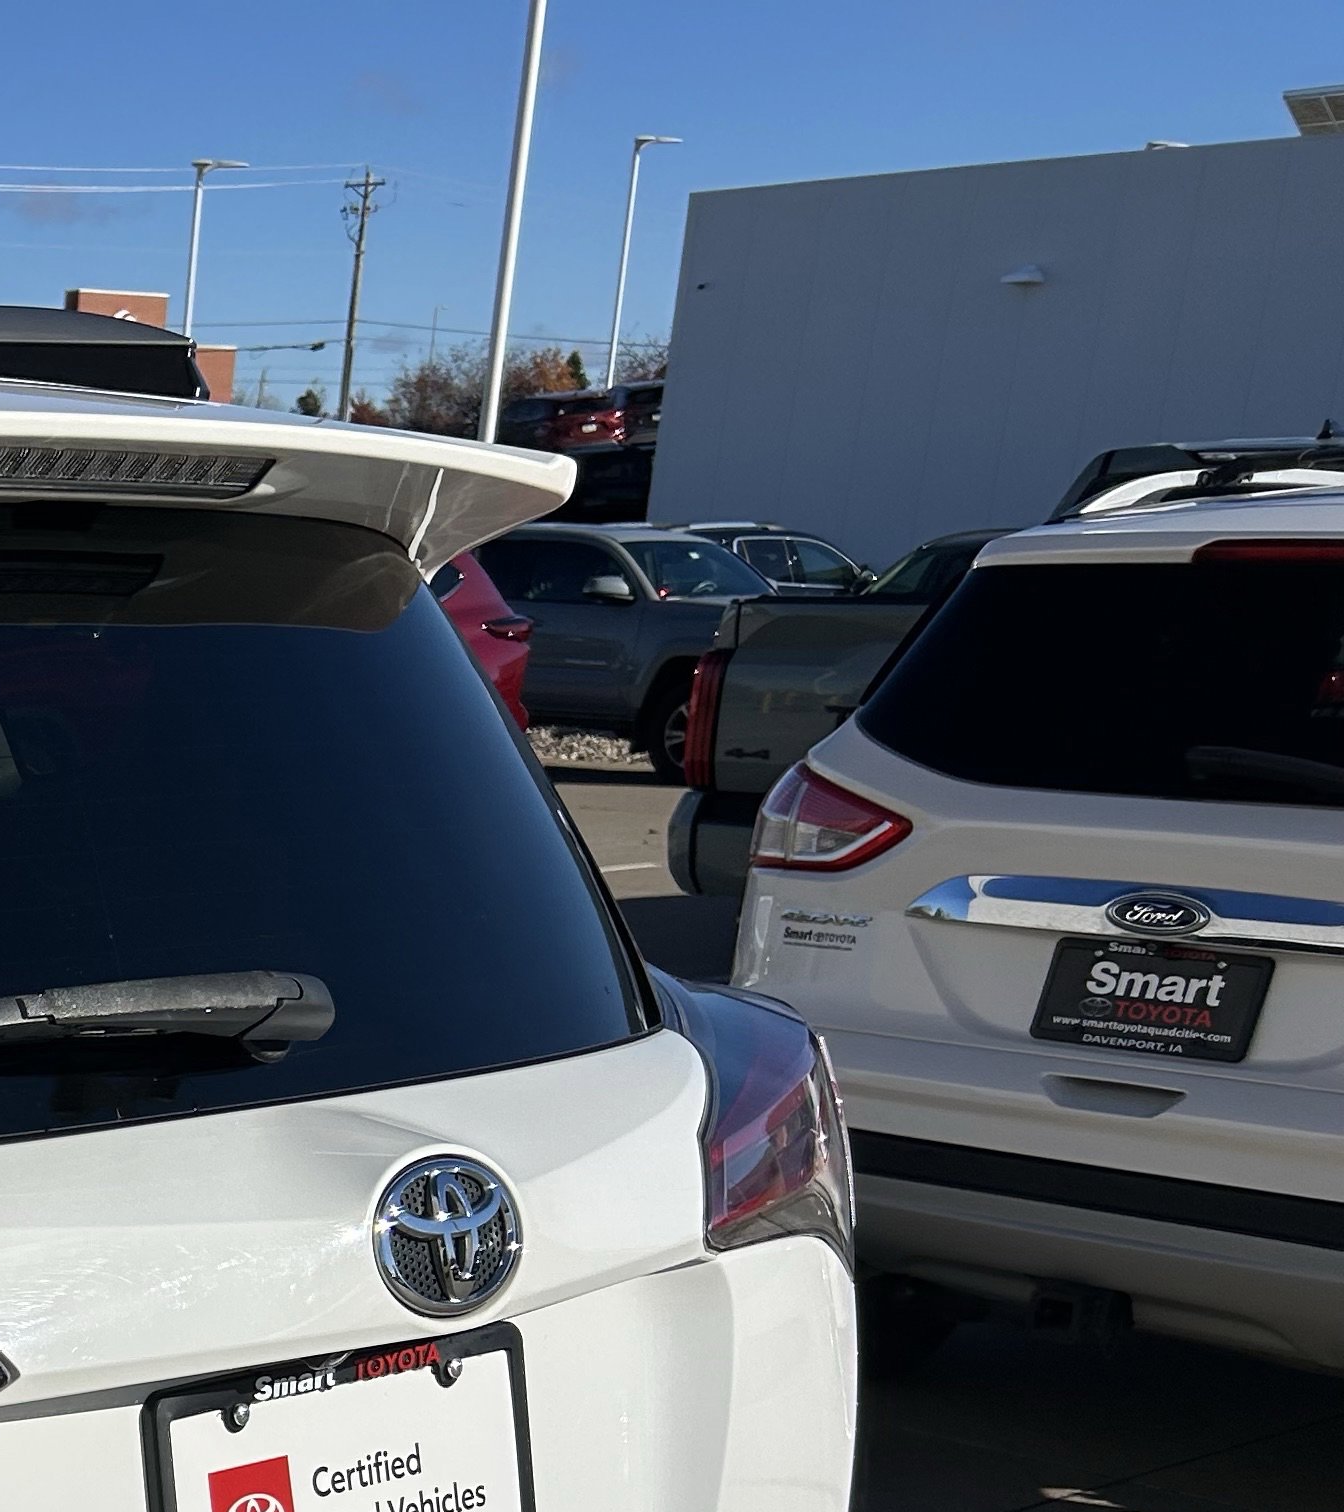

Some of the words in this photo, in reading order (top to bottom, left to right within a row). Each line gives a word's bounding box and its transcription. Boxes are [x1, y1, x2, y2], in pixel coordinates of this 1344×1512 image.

[1125, 902, 1185, 926] Ford
[784, 926, 813, 941] Smart
[825, 932, 857, 945] TOYOTA
[1086, 961, 1226, 1007] Smart
[1115, 1000, 1212, 1028] TOYOTA
[1082, 1033, 1166, 1053] DAVENPORT,
[1168, 1043, 1183, 1053] IA
[253, 1367, 336, 1402] Smart
[354, 1343, 441, 1381] TOYOTA
[312, 1443, 422, 1498] Certified
